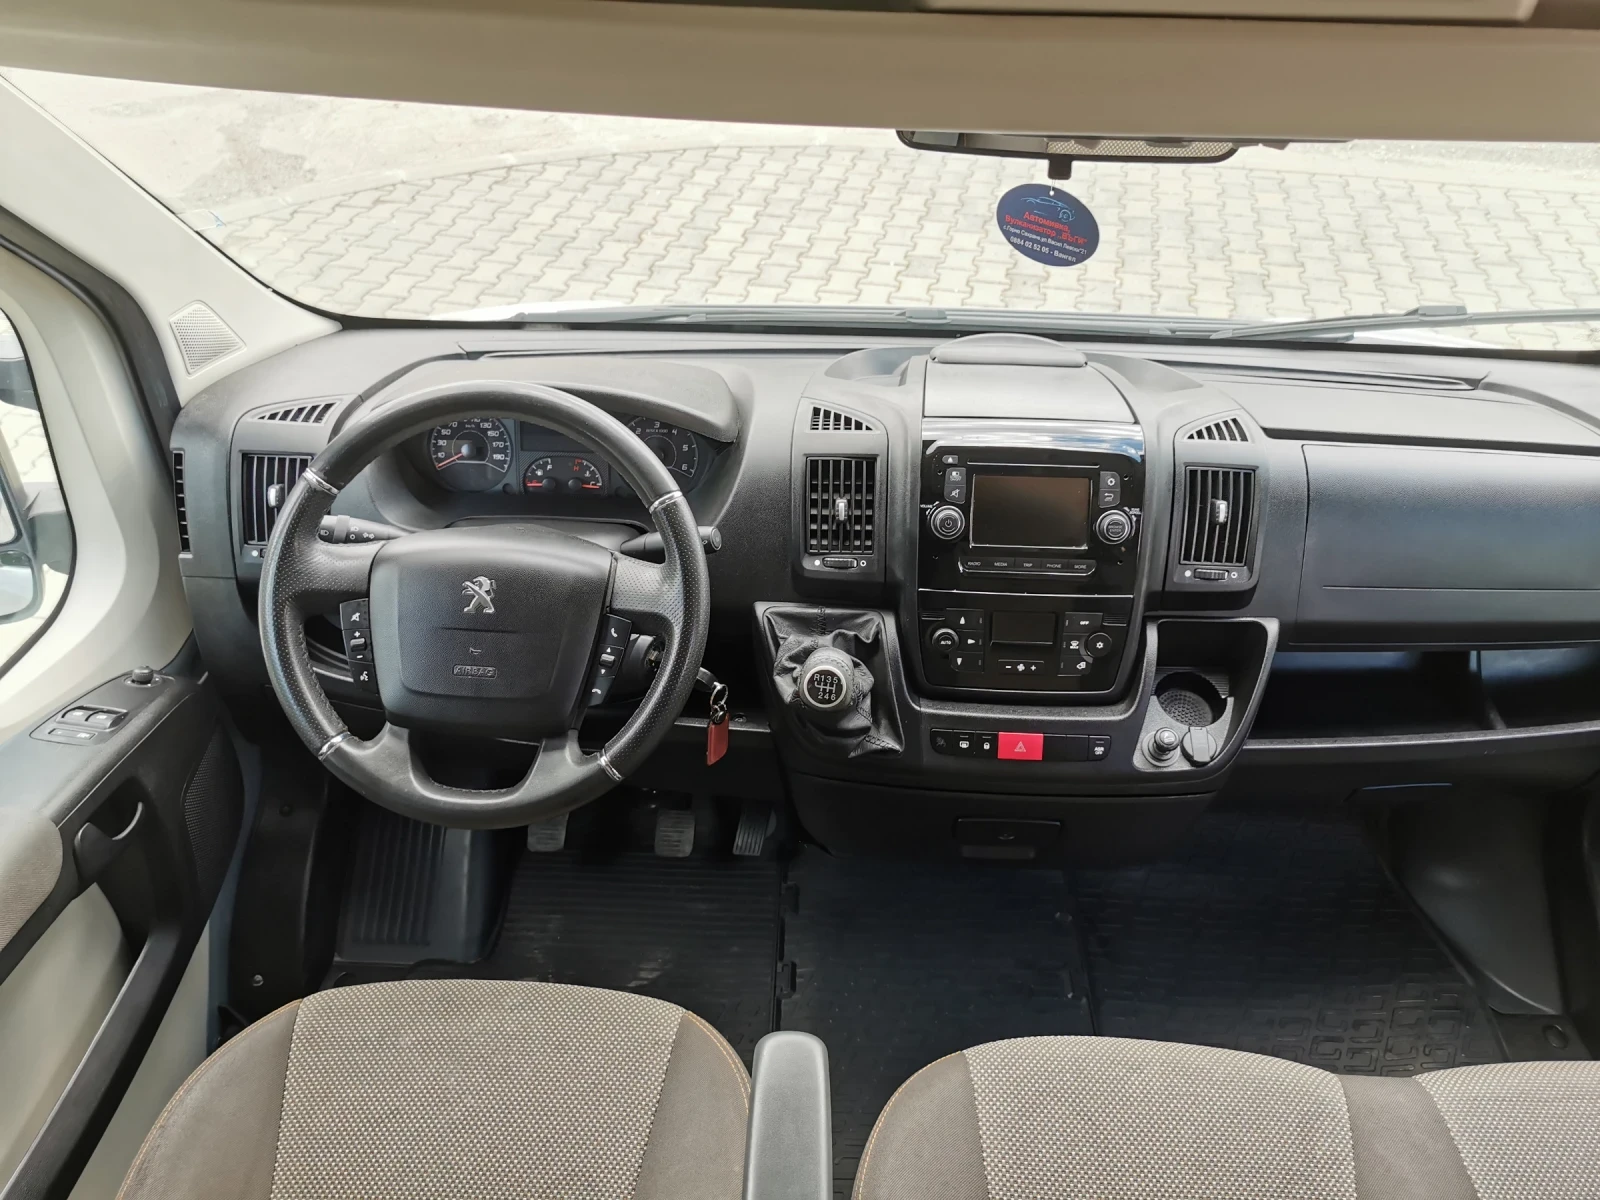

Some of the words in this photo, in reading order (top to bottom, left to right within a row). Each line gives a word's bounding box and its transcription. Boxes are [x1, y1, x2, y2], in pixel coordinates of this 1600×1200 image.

[1005, 214, 1056, 238] Вулканизатор
[653, 421, 661, 429] 3
[441, 428, 451, 436] 50
[635, 427, 642, 435] 2
[671, 428, 678, 436] 4
[682, 444, 689, 452] 5
[681, 463, 688, 471] 6
[454, 666, 495, 677] AIRBAG
